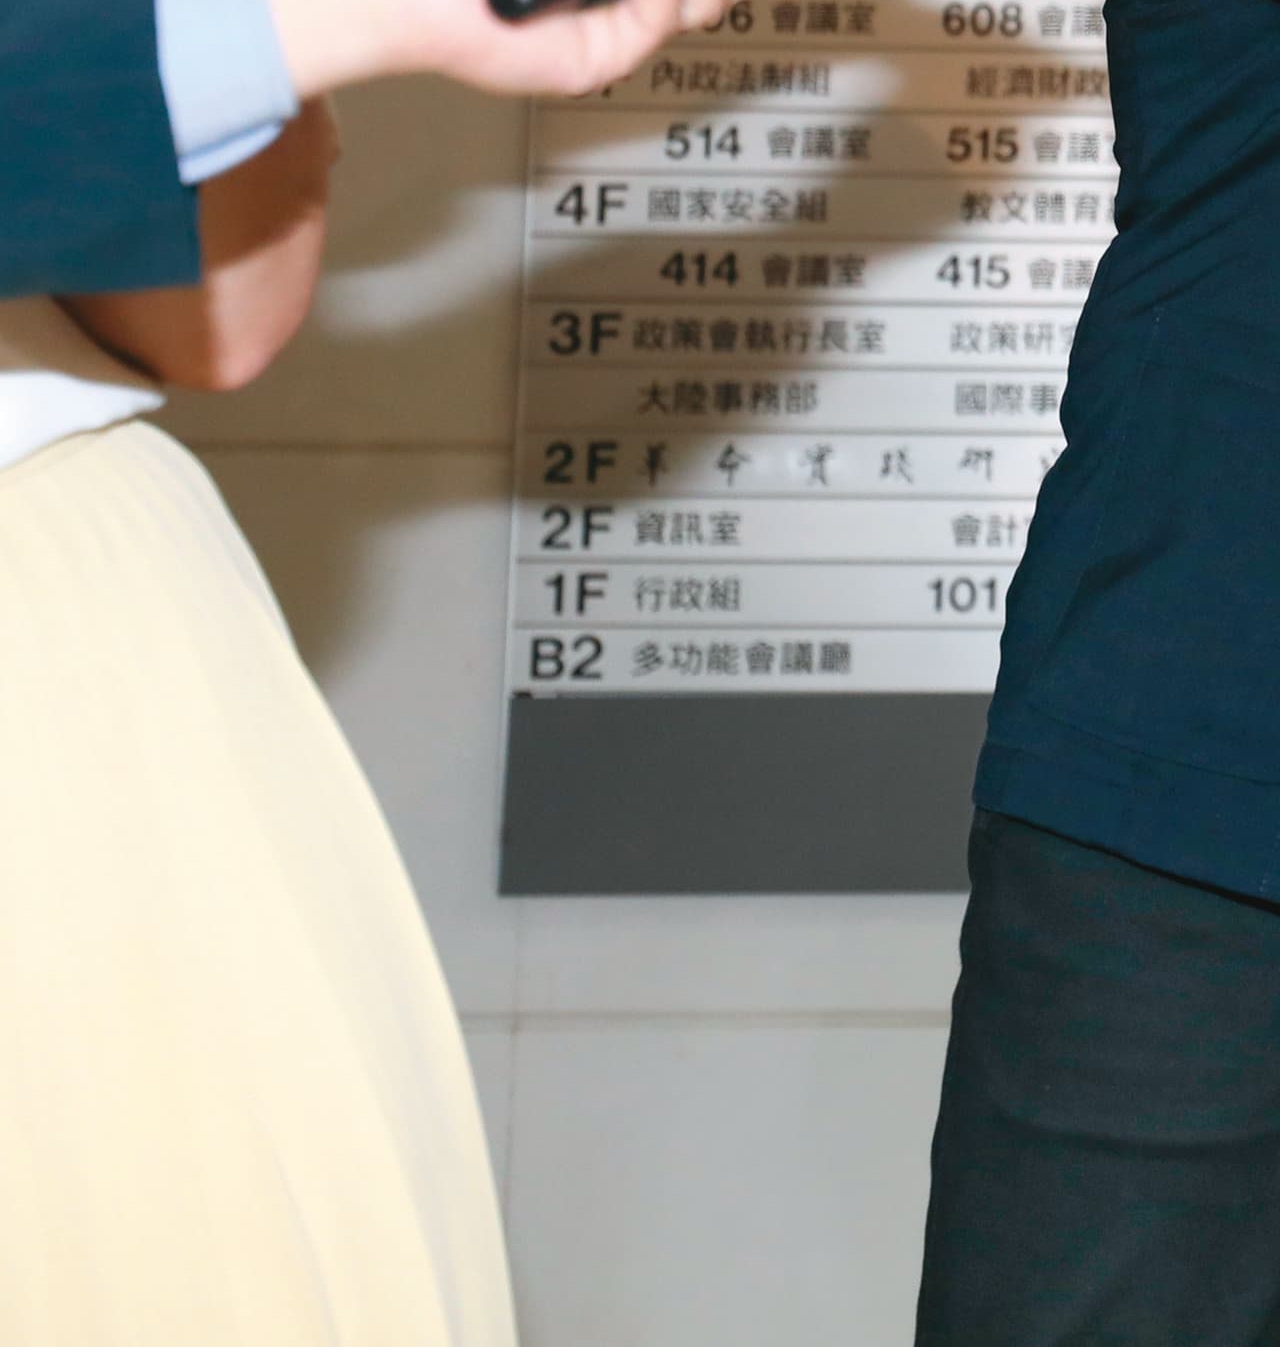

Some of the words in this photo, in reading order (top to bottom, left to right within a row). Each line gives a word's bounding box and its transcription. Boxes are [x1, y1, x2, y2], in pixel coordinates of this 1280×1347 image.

[942, 3, 1024, 37] 608
[665, 123, 741, 160] 514
[767, 126, 872, 160] 會議室
[946, 127, 1018, 163] 515
[1034, 132, 1115, 163] 會議
[555, 182, 628, 225] 4F
[648, 188, 828, 223] 國家安全組
[962, 189, 1116, 225] 教文體育
[660, 251, 739, 287] 414
[762, 254, 866, 289] 會議室
[936, 255, 1010, 290] 415
[549, 311, 623, 357] 3F
[633, 318, 886, 354] 政策會執行長室
[638, 381, 820, 416] 大陸事務部
[543, 440, 617, 486] 2F
[541, 507, 614, 550] 2F
[634, 511, 742, 547] 資訊室
[952, 514, 1034, 548] 會計
[546, 572, 609, 616] 1F
[635, 576, 741, 613] 行政組
[928, 577, 998, 614] 101
[529, 635, 603, 681] B2
[630, 641, 852, 678] 多功能會議廳
